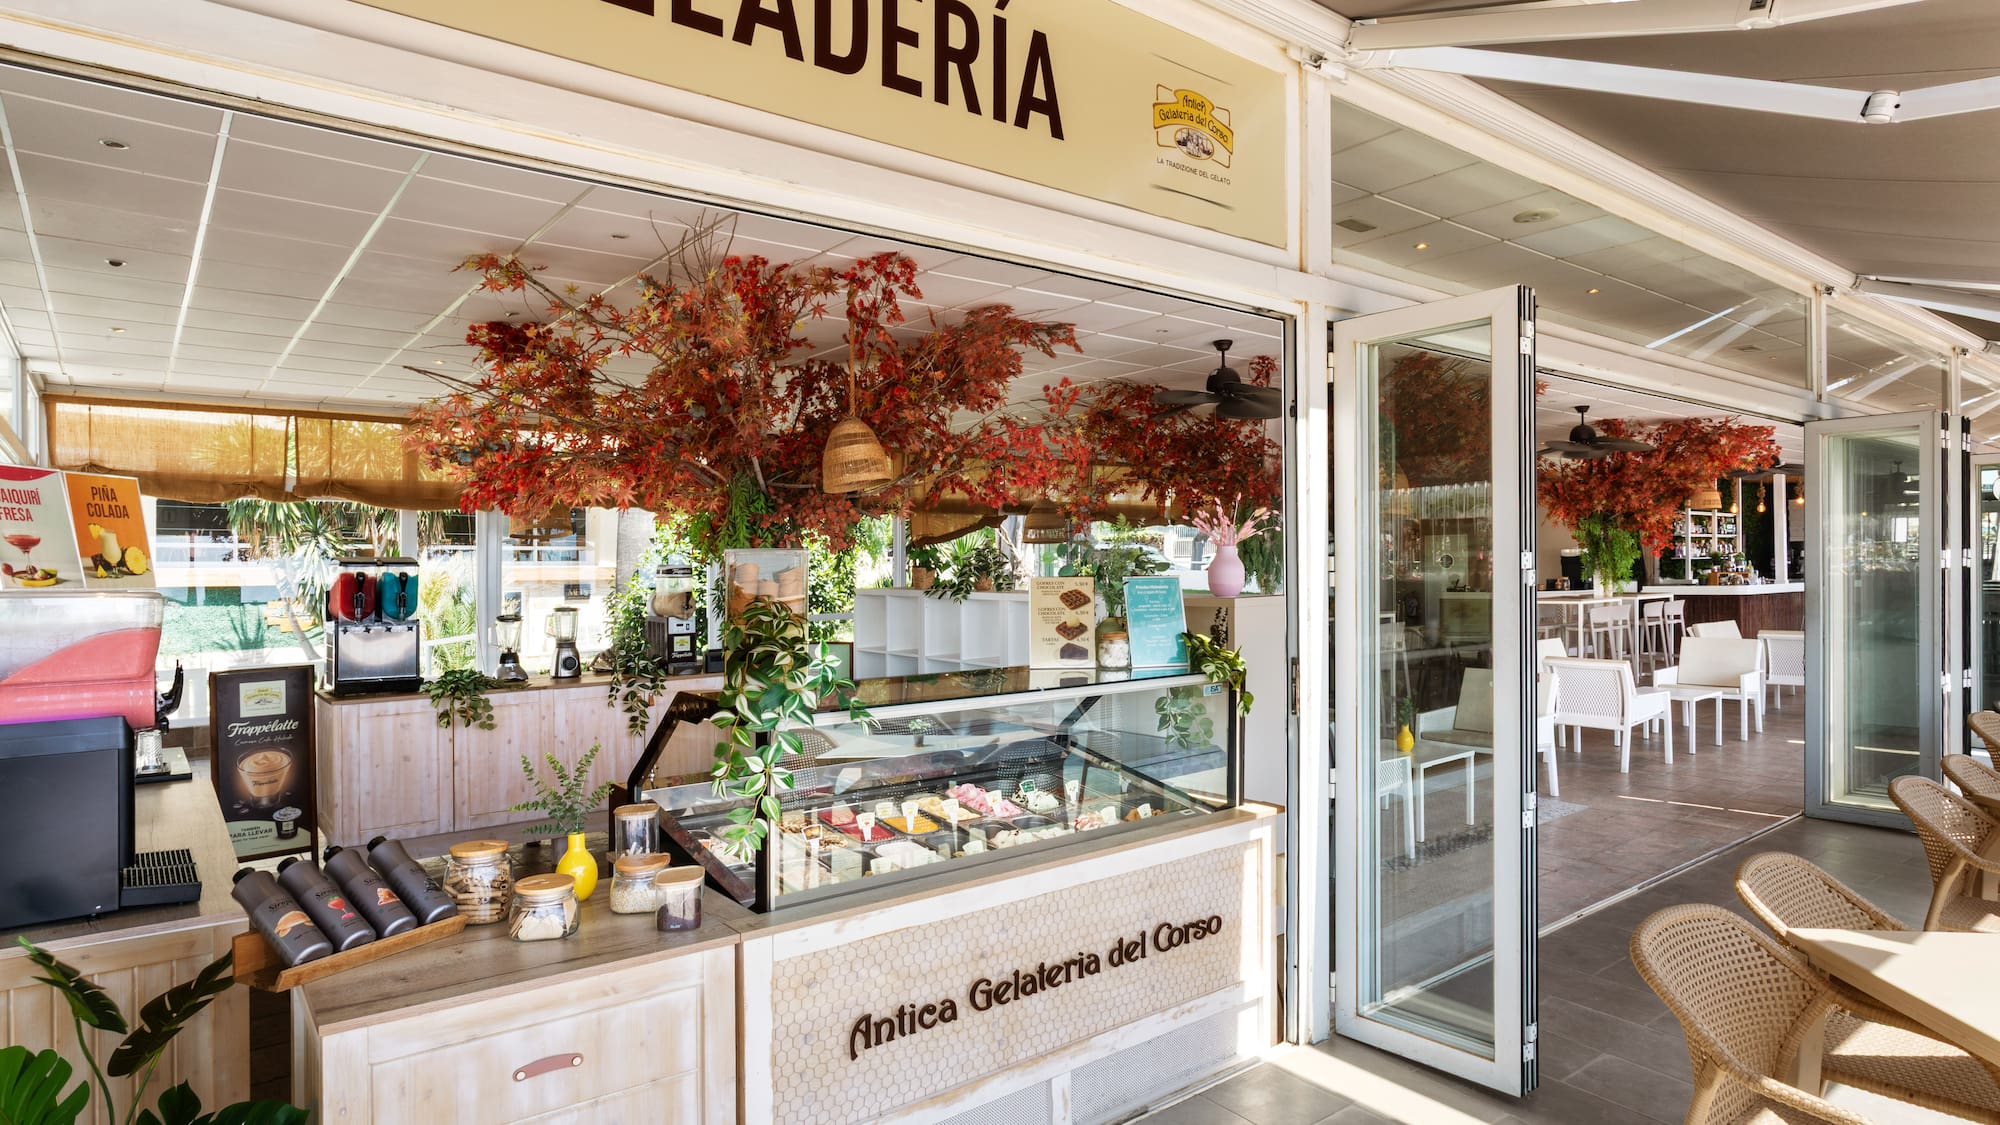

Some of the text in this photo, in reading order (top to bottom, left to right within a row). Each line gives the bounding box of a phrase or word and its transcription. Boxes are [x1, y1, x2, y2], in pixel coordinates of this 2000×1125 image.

[1158, 108, 1229, 143] Gelateria del Corso
[1156, 156, 1231, 185] LA TRADIZIONE DEL GELATO
[0, 487, 41, 505] AIQUIRÍ
[91, 484, 118, 502] PIÑA
[86, 502, 130, 519] COLADA
[227, 719, 300, 738] Frappélatte
[849, 914, 1222, 1061] Antica Gelateria del Corso
